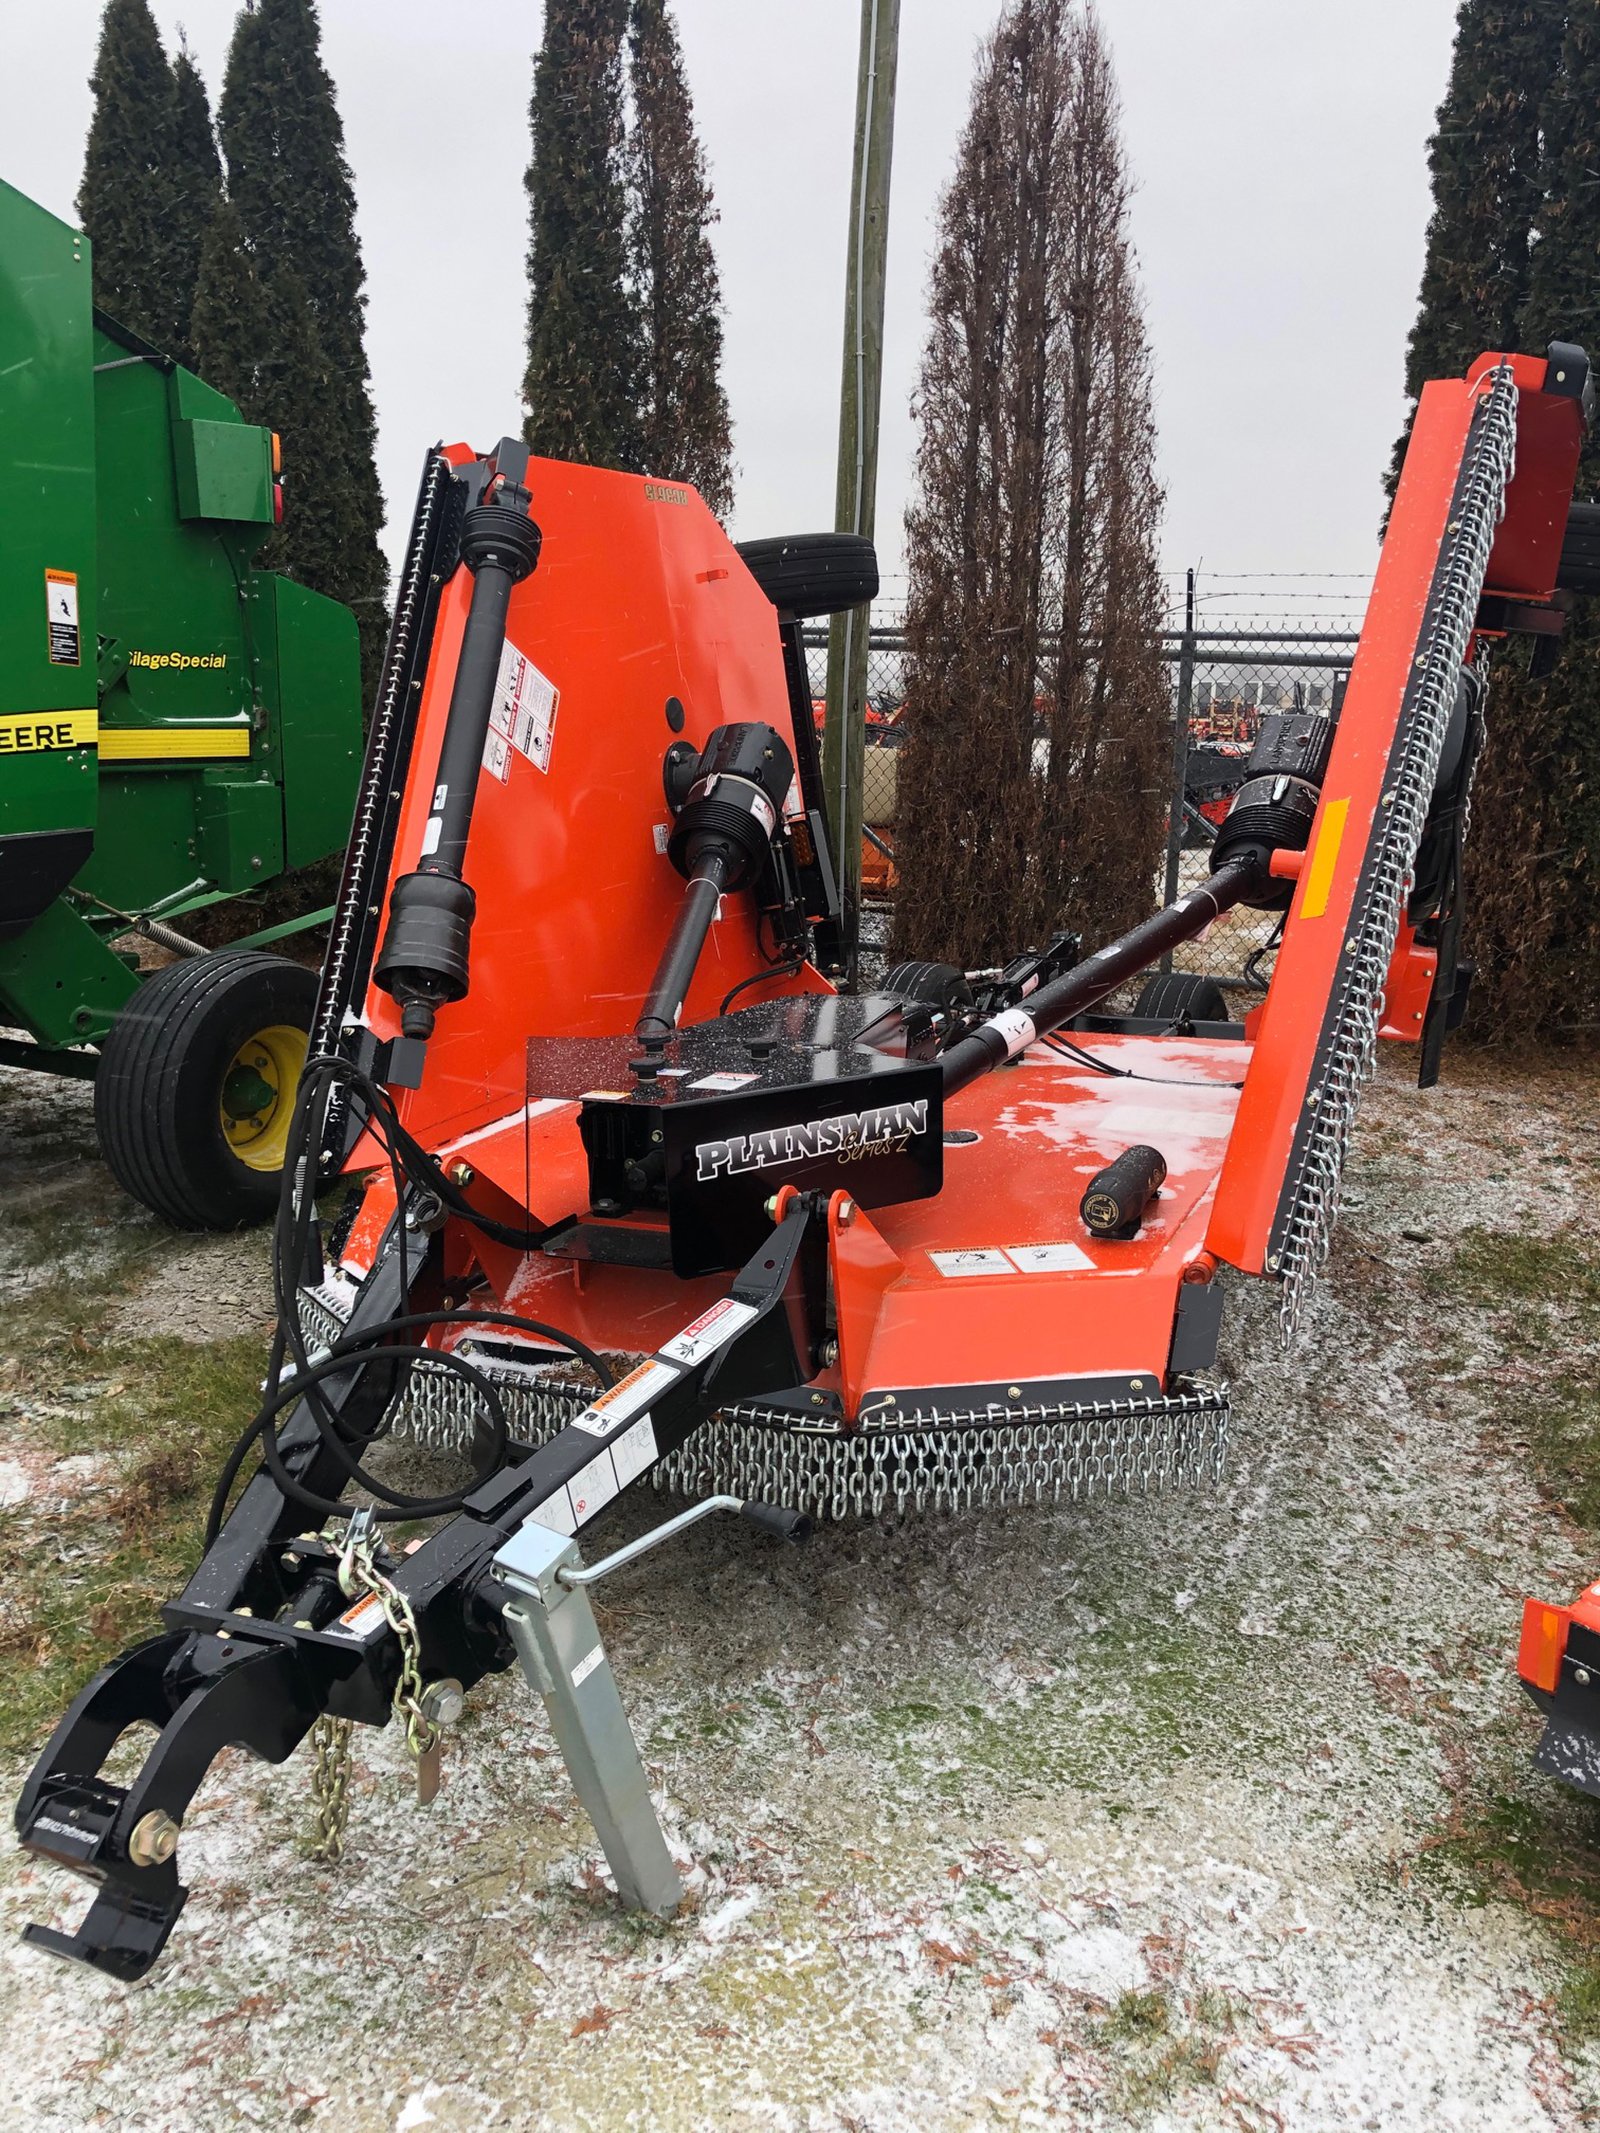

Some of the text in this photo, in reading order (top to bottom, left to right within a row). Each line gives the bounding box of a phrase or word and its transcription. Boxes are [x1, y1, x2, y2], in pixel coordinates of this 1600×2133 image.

[696, 1099, 928, 1182] PLAINSMAN
[837, 1127, 912, 1164] Series 2
[696, 1301, 732, 1330] DANGER
[607, 1366, 650, 1400] WARNING
